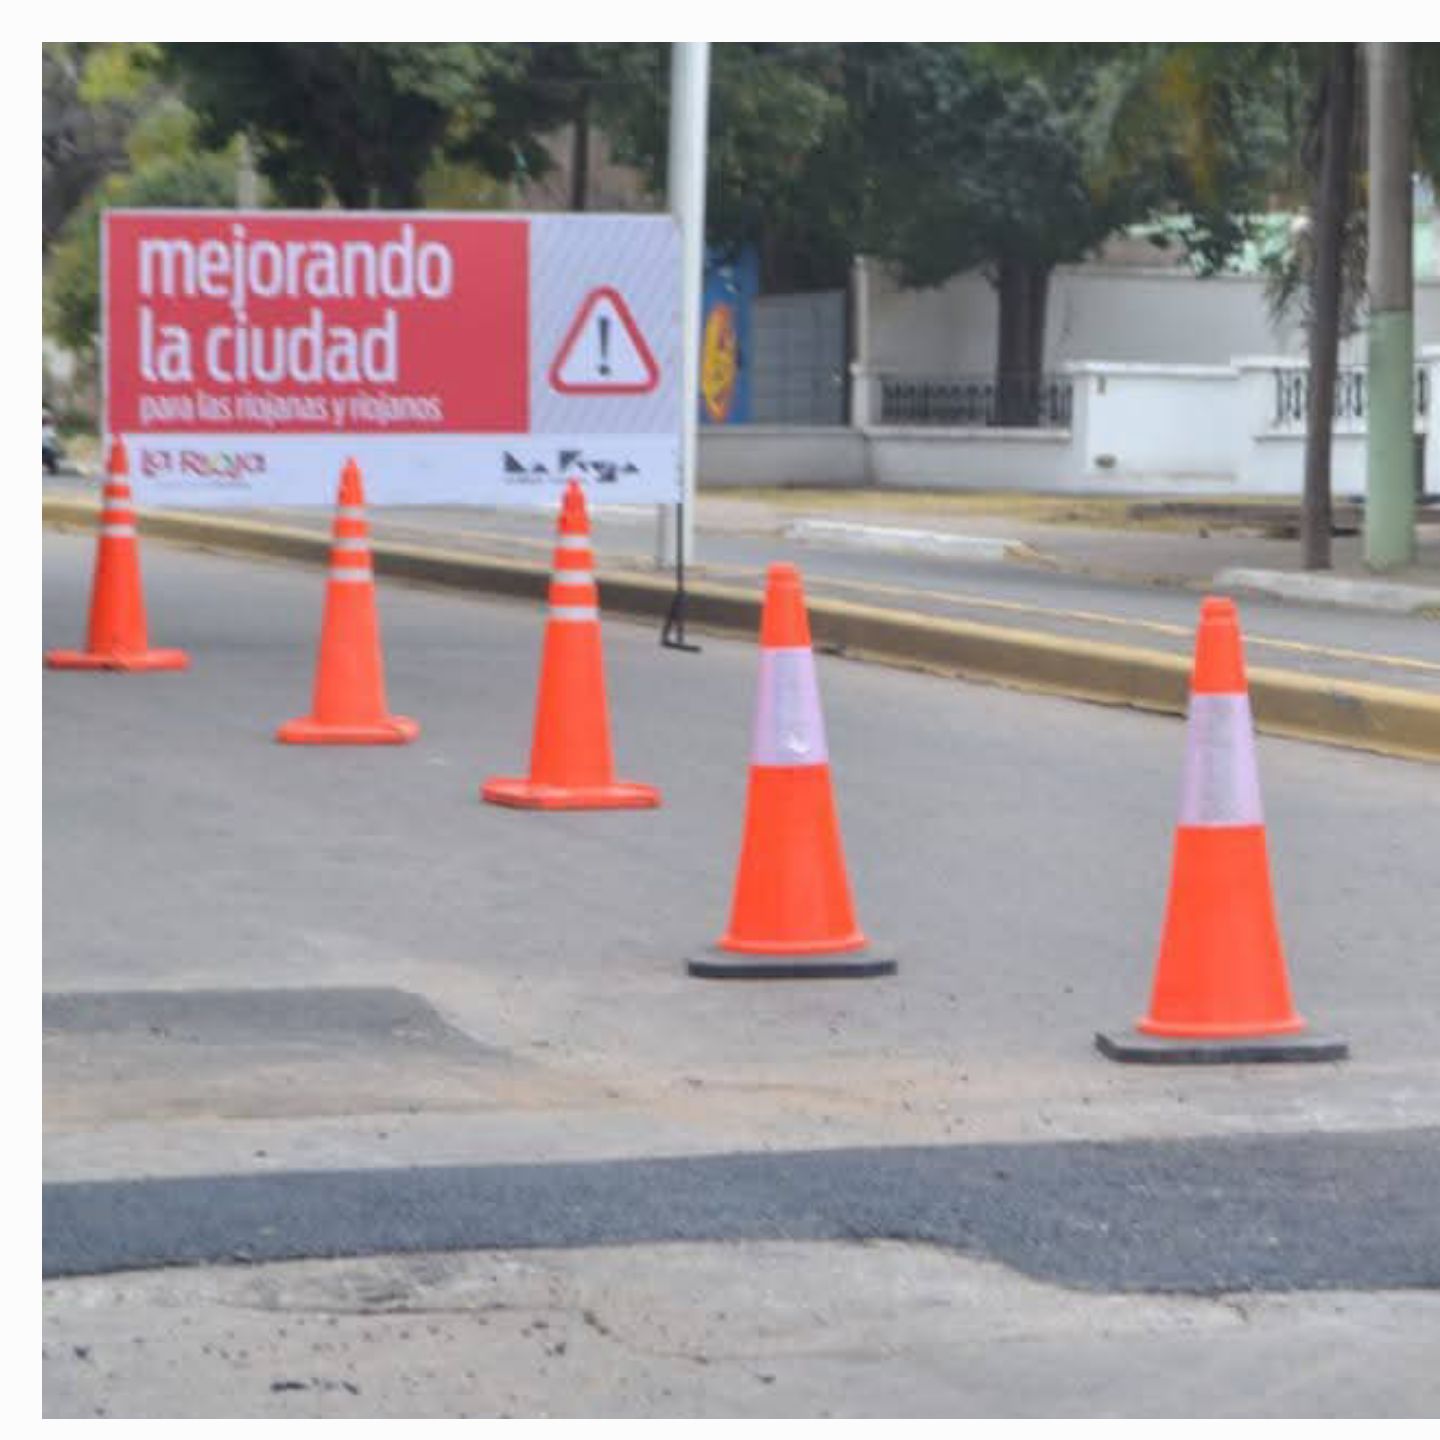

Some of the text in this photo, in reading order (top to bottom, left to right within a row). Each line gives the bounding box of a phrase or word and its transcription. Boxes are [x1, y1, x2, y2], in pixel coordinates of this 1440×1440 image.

[138, 223, 453, 307] mejorando
[139, 304, 398, 383] la ciudad
[139, 391, 444, 429] para las riojanas y riojanos
